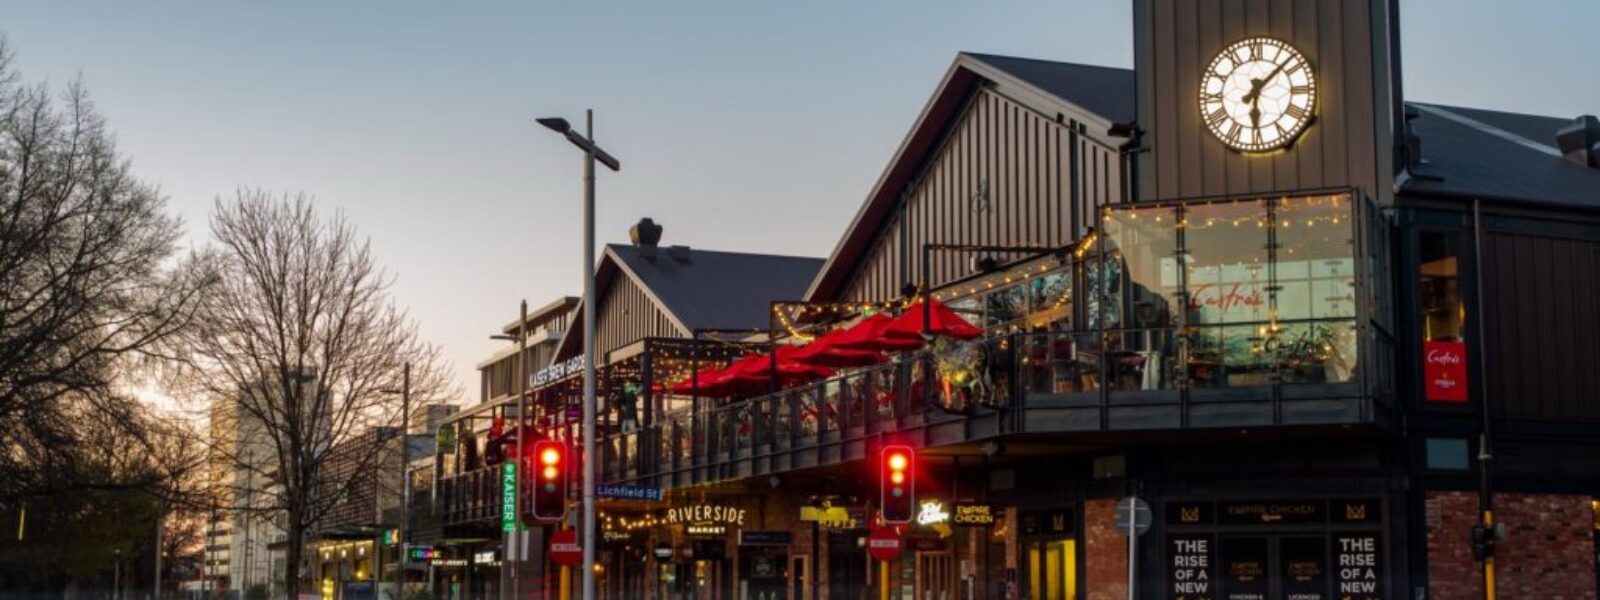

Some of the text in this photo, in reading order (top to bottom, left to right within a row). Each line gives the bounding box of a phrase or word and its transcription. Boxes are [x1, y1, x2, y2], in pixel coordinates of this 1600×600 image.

[566, 354, 586, 374] GARDE
[503, 474, 516, 521] KAISER
[597, 485, 658, 498] Lichfield St
[667, 505, 746, 525] RIVERSIDE
[957, 505, 991, 515] EMPIRE
[954, 514, 994, 524] CHICKEN
[687, 526, 726, 534] MARKET
[1174, 540, 1208, 553] THE
[1340, 538, 1374, 551] THE
[1174, 555, 1208, 567] RISE
[1340, 554, 1375, 566] RISE
[1175, 570, 1208, 580] OF A
[1340, 568, 1376, 580] OF A
[1175, 582, 1208, 593] NEW
[1340, 582, 1376, 593] NEW
